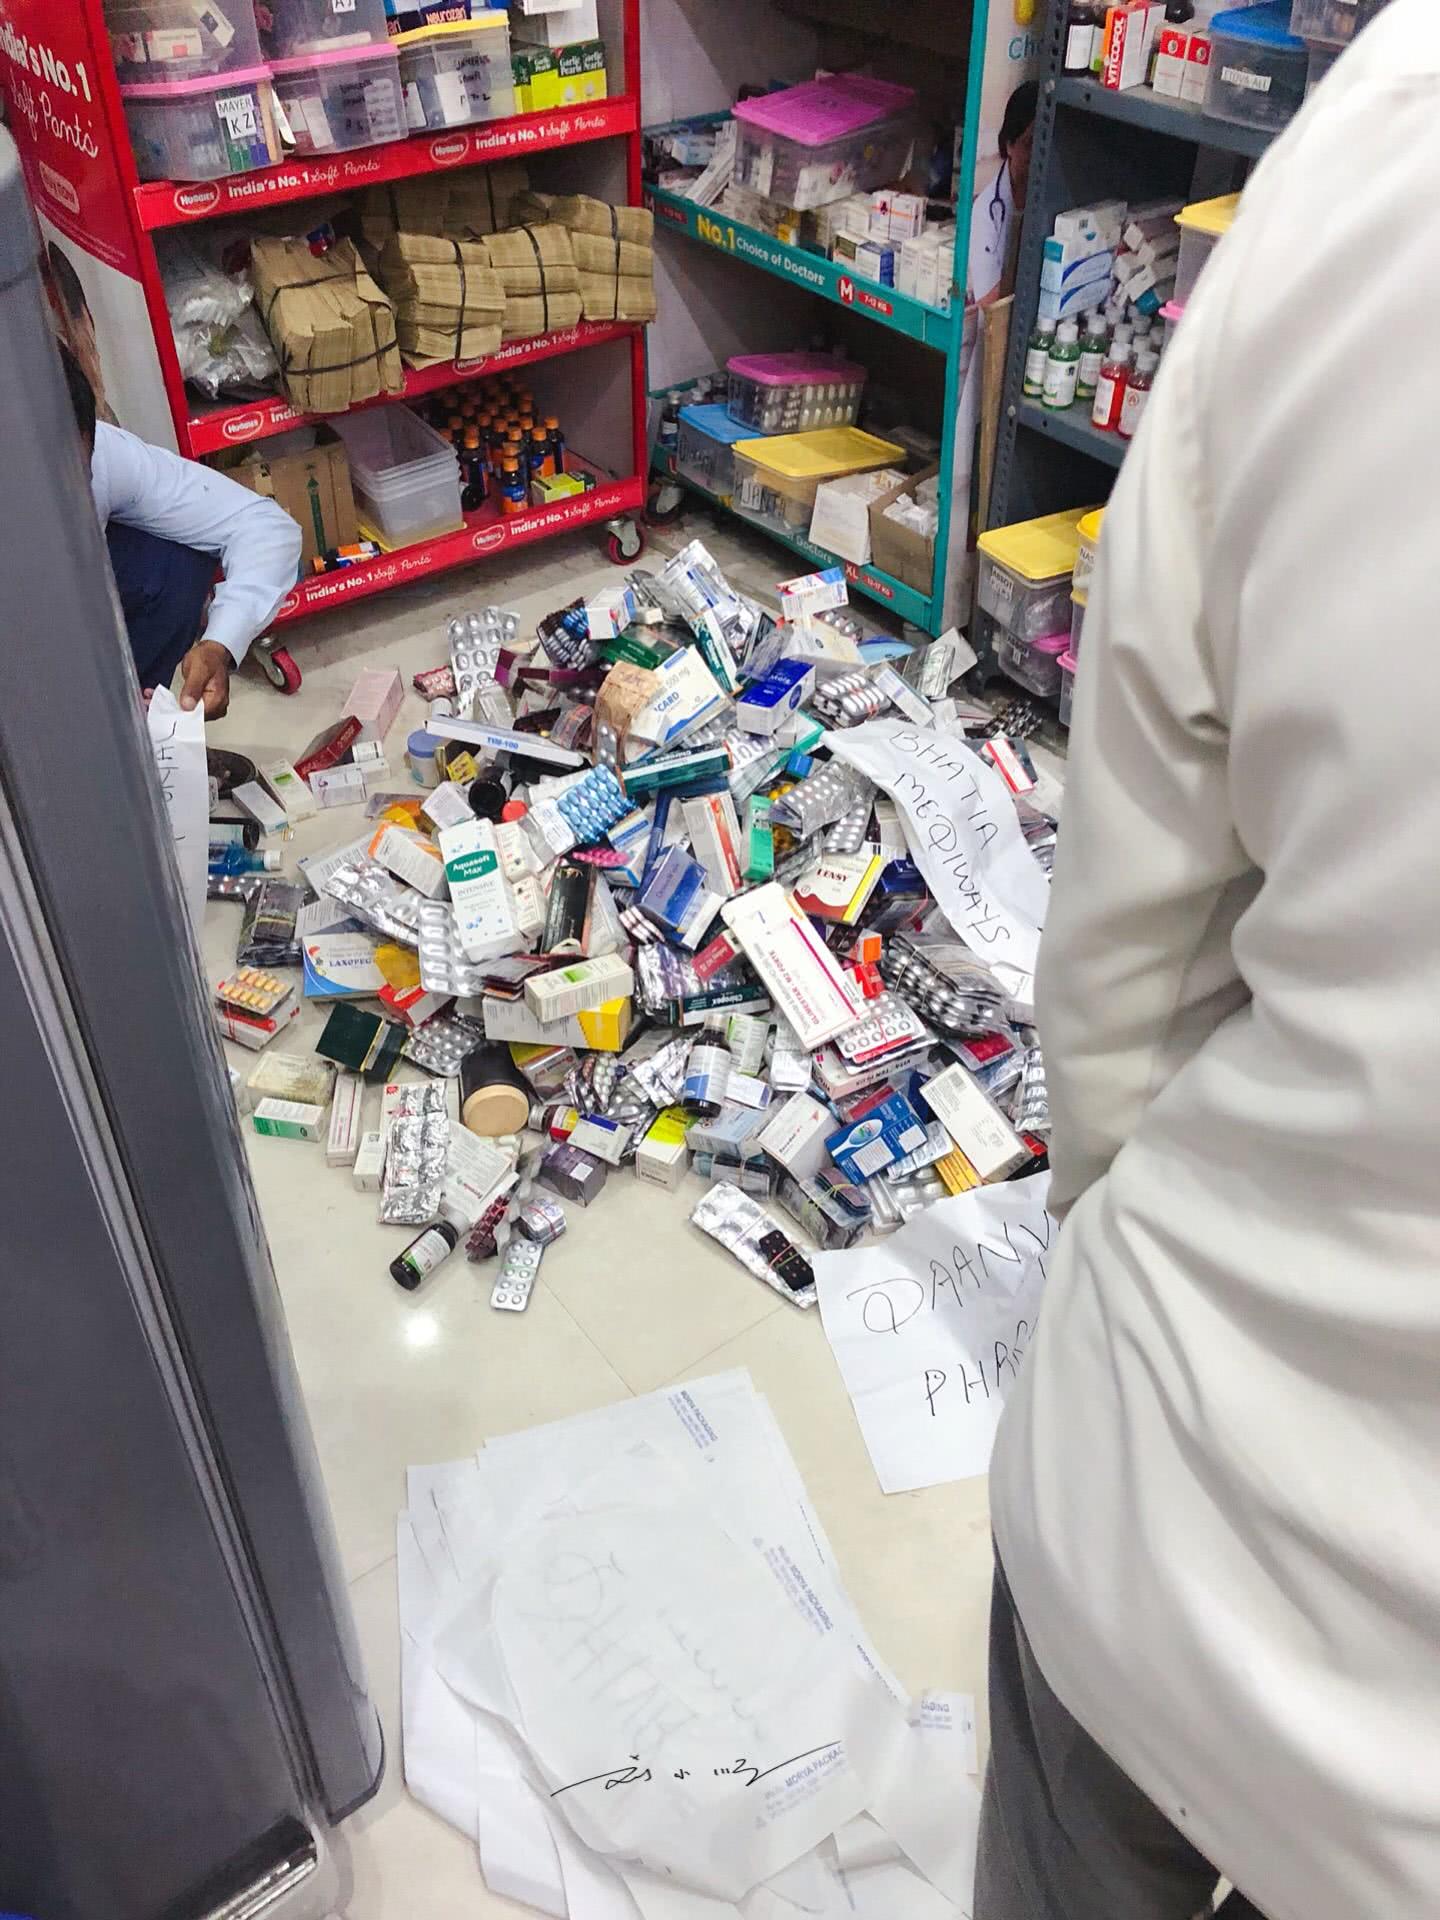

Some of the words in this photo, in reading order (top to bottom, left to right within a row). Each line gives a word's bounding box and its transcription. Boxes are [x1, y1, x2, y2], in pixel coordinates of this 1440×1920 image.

[218, 96, 253, 114] MAYER
[475, 132, 516, 150] India's
[228, 180, 277, 199] India's
[737, 236, 769, 262] Choice
[771, 251, 782, 266] of
[784, 256, 825, 286] Doctors
[841, 279, 853, 301] M
[511, 518, 546, 536] India's
[306, 580, 346, 602] India's
[890, 730, 999, 850] BHATIA
[453, 854, 490, 871] Aquasoft
[463, 866, 482, 878] Max
